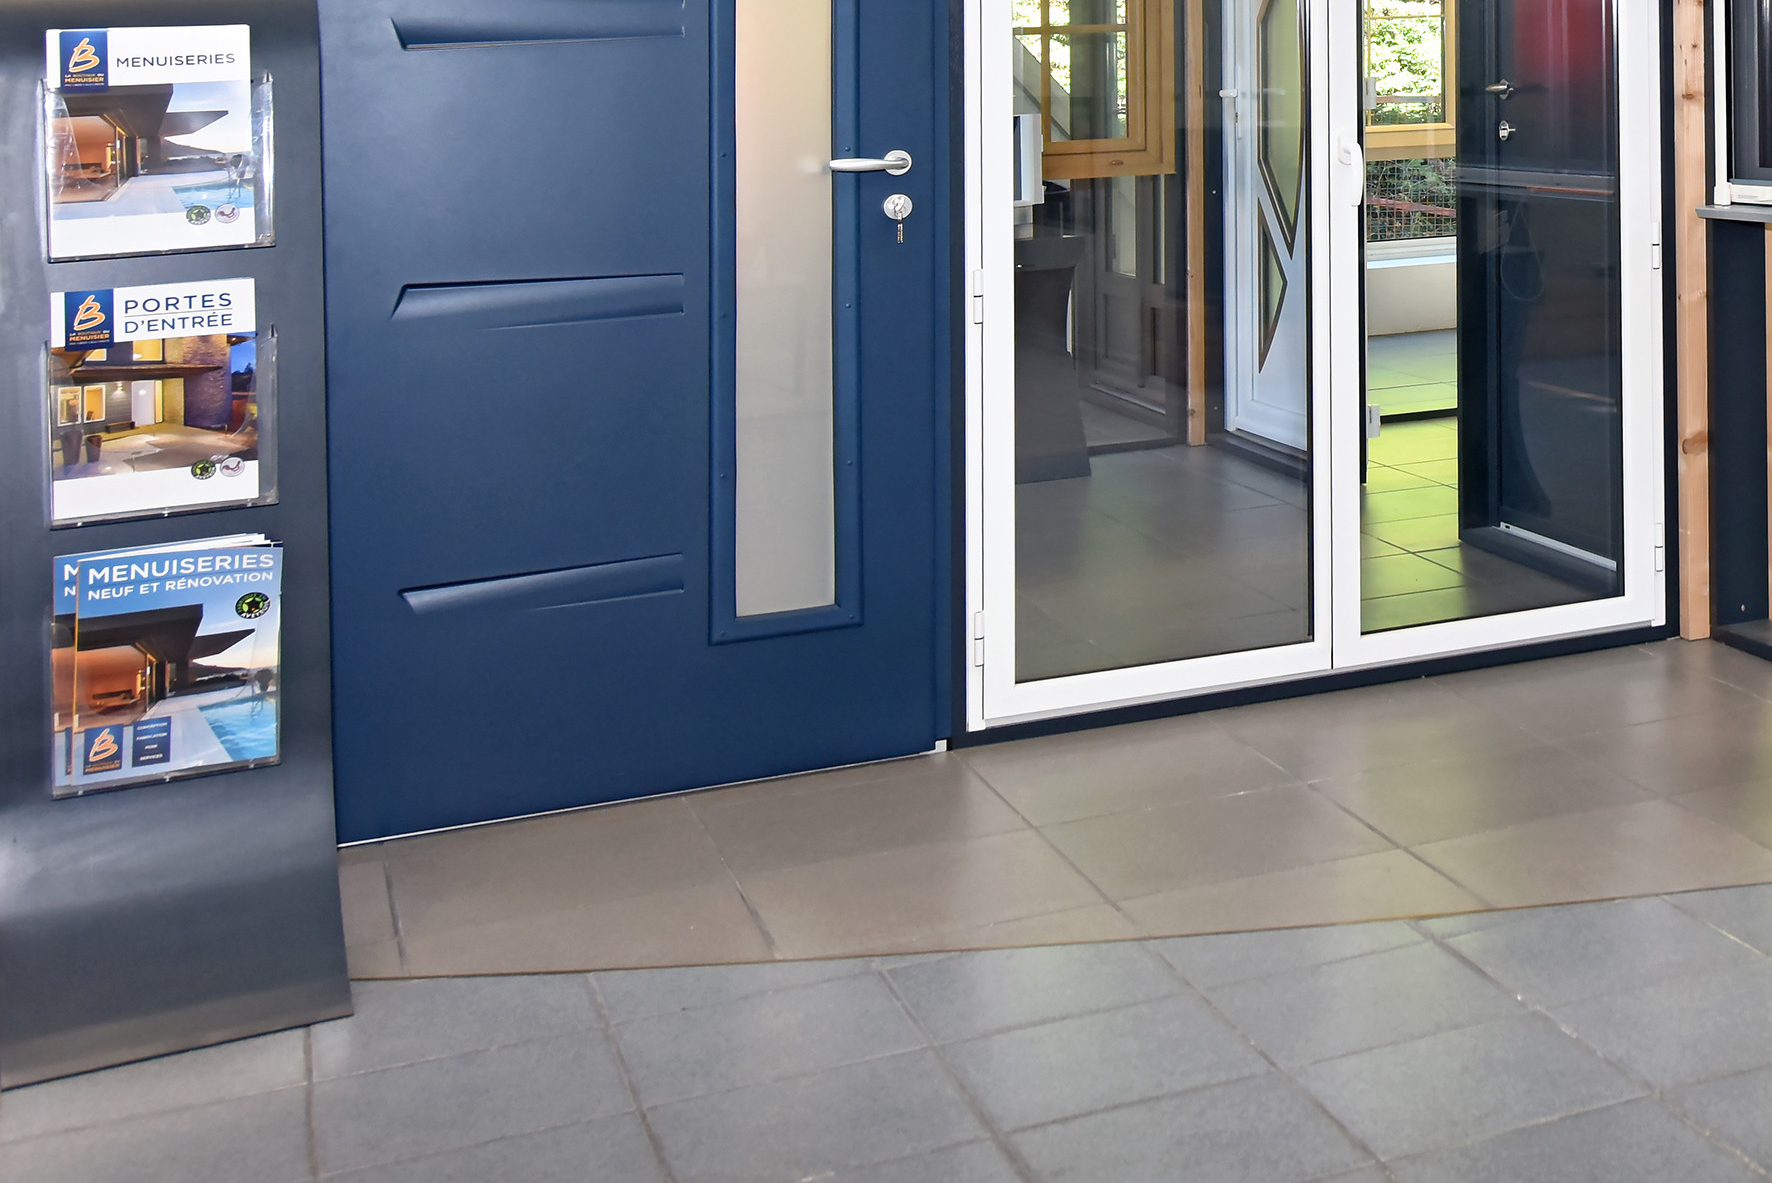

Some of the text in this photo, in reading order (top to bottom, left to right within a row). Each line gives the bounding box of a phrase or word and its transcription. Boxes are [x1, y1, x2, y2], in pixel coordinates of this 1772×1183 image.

[69, 37, 100, 72] B
[116, 53, 236, 68] MENUISERIES
[73, 295, 106, 331] B
[124, 292, 232, 315] PORTES
[69, 333, 110, 342] MENUISIER
[124, 311, 233, 334] D'ENTRÉE
[88, 554, 275, 585] MENUISERIES
[87, 584, 135, 601] NEUF
[139, 582, 160, 595] ET
[165, 571, 274, 591] RÉNOVATION
[88, 727, 119, 762] B
